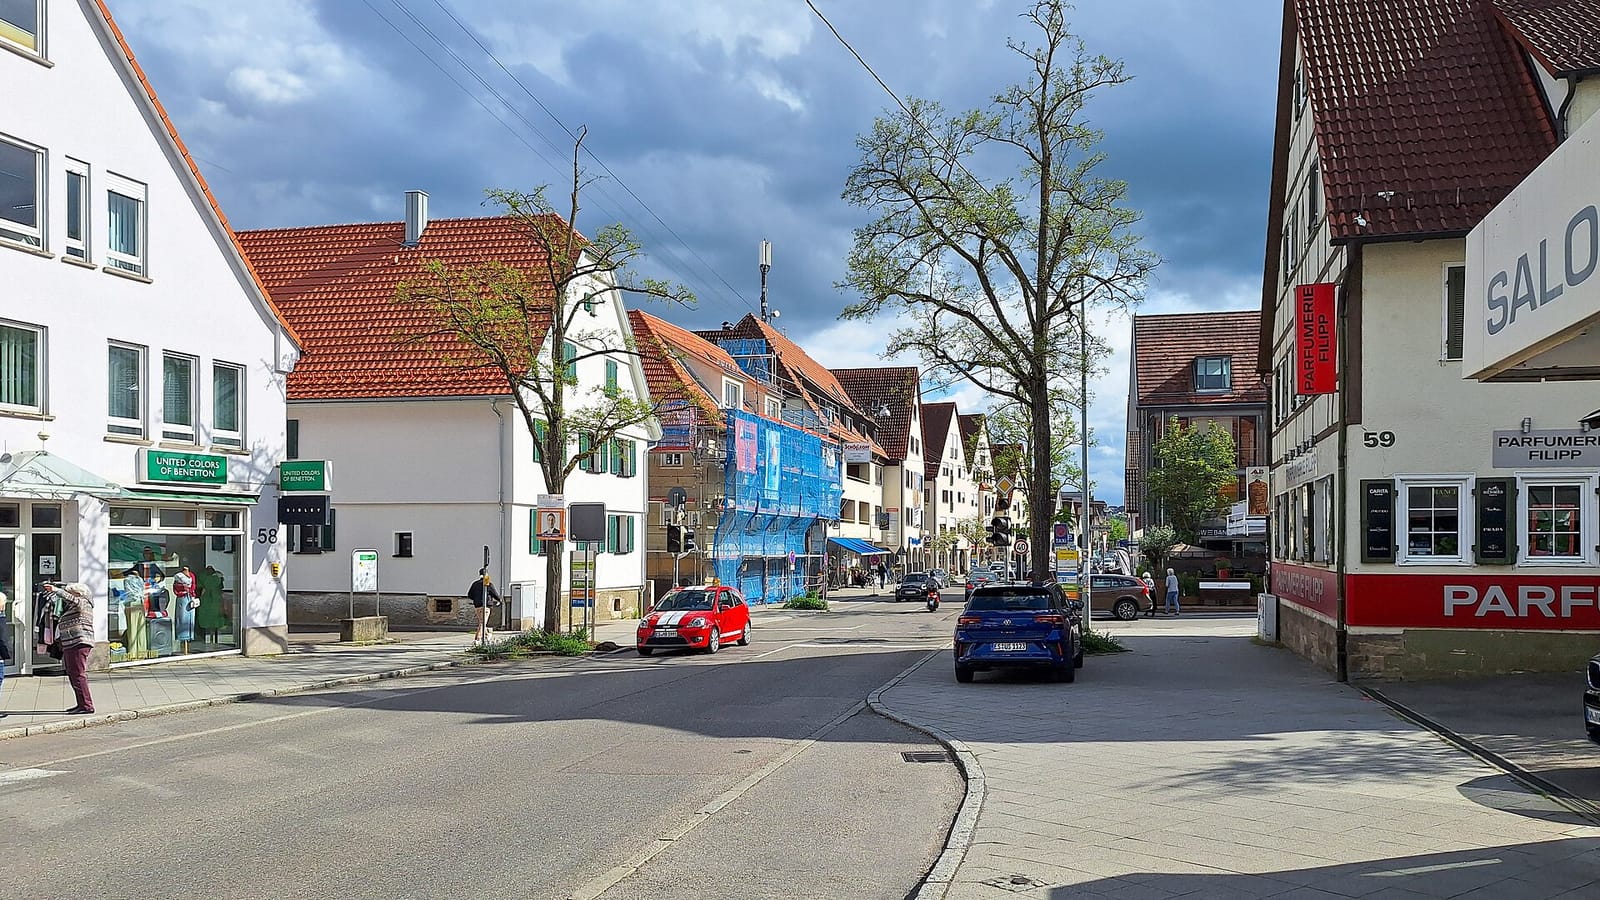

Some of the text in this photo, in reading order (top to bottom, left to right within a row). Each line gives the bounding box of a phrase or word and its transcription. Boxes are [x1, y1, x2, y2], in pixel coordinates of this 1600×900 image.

[1487, 205, 1599, 336] SALO
[1303, 287, 1315, 391] PARFUMERIE
[1318, 314, 1329, 362] FILIPP
[1363, 431, 1396, 448] 59
[156, 457, 220, 469] UNITED COLORS
[1528, 450, 1583, 460] FILIPP
[160, 466, 172, 475] OF
[257, 528, 278, 544] 58
[1443, 585, 1600, 618] PARF
